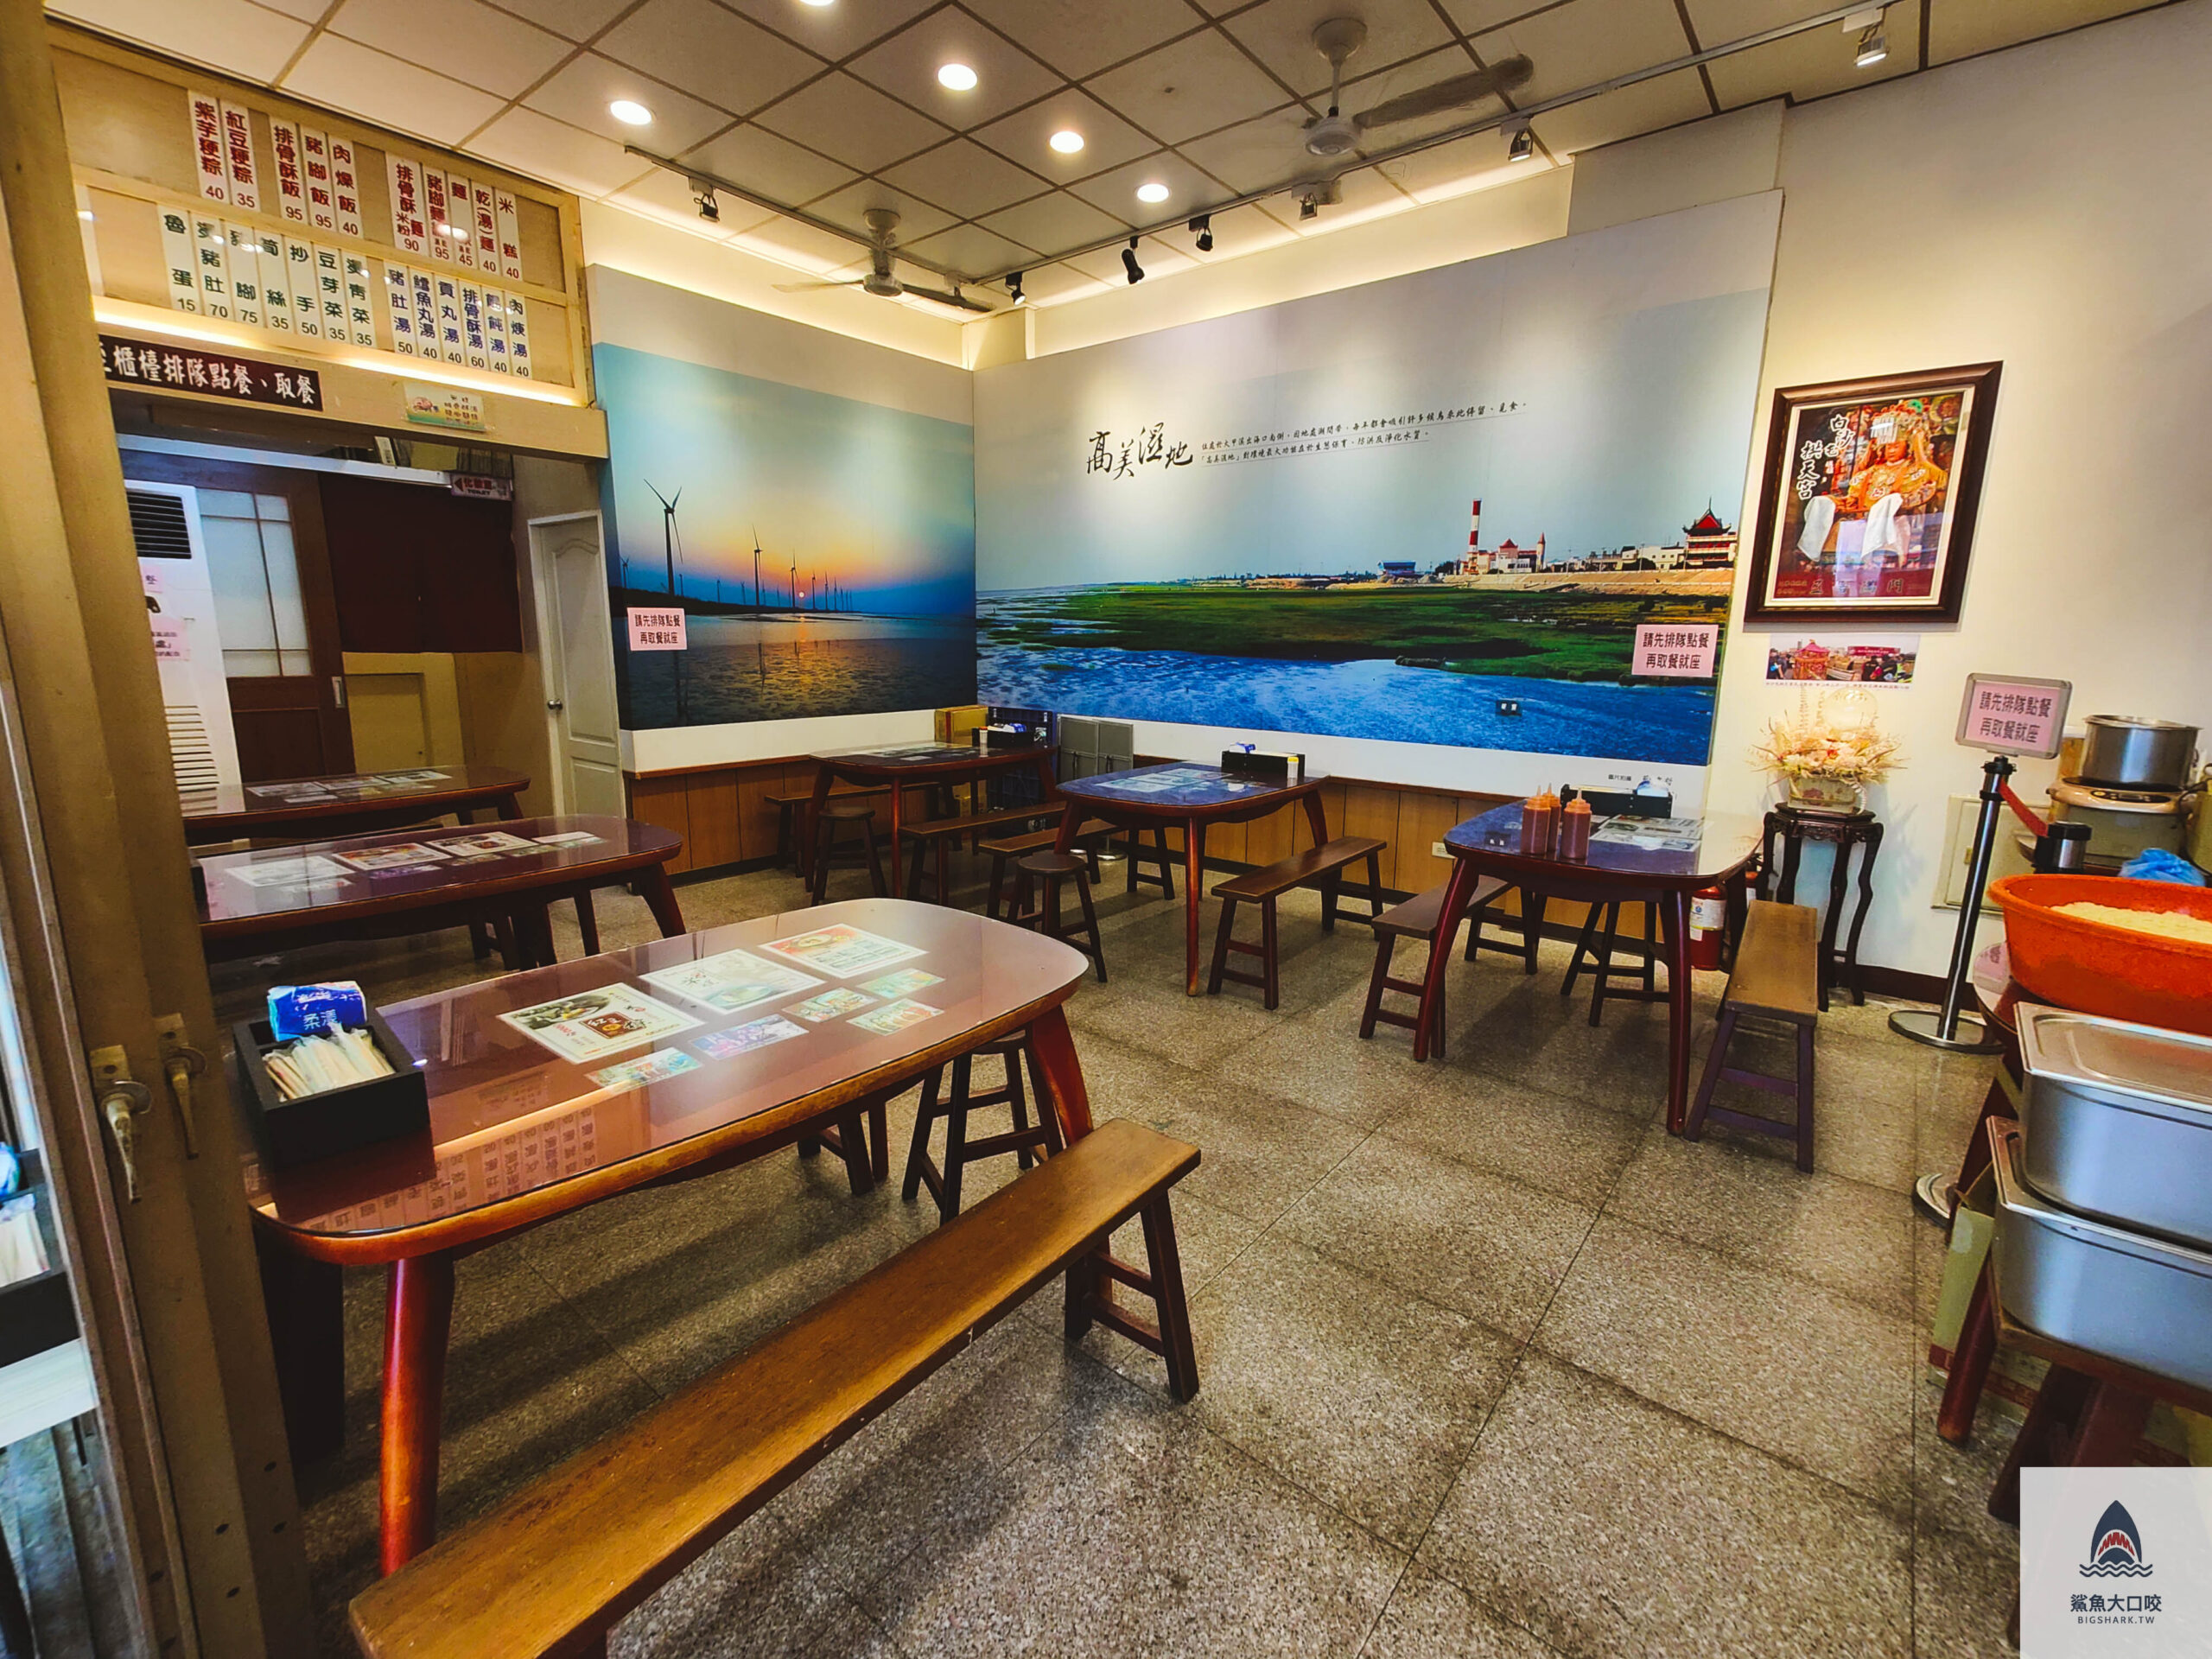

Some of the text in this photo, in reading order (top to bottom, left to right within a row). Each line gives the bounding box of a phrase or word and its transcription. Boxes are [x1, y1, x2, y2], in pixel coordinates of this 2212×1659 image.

[274, 126, 301, 199] 排骨酥飯
[305, 136, 330, 207] 豬腳飯
[206, 186, 224, 200] 40
[396, 163, 416, 213] 排骨酥
[237, 194, 255, 207] 35
[285, 207, 302, 219] 95
[315, 215, 332, 228] 95
[343, 223, 359, 235] 40
[163, 213, 193, 289] 魯蛋
[404, 238, 419, 251] 90
[435, 247, 449, 260] 95
[459, 254, 473, 266] 45
[483, 260, 496, 272] 40
[506, 267, 519, 279] 40
[318, 251, 343, 319] 豆芽菜
[177, 298, 196, 312] 15
[388, 269, 411, 334] 豬肚湯
[210, 304, 228, 318] 70
[240, 309, 258, 324] 75
[437, 281, 460, 344] 貢丸湯
[271, 316, 289, 329] 35
[462, 288, 484, 349] 排骨酥湯
[302, 322, 318, 335] 50
[329, 327, 346, 340] 35
[357, 333, 372, 346] 35
[398, 341, 413, 354] 50
[423, 347, 437, 359] 40
[448, 353, 461, 364] 40
[471, 357, 485, 368] 60
[494, 362, 507, 373] 40
[516, 366, 529, 378] 40
[1087, 423, 1193, 480] 高美濕地
[1796, 440, 1823, 500] 拱天宮
[634, 614, 681, 627] 請先排隊點餐
[640, 632, 678, 645] 再取餐就座
[1643, 632, 1709, 648] 請先排隊點餐
[1646, 653, 1701, 670] 再取餐就座
[1980, 691, 2052, 718] 請先排隊點餐
[1980, 717, 2041, 743] 再取餐就座
